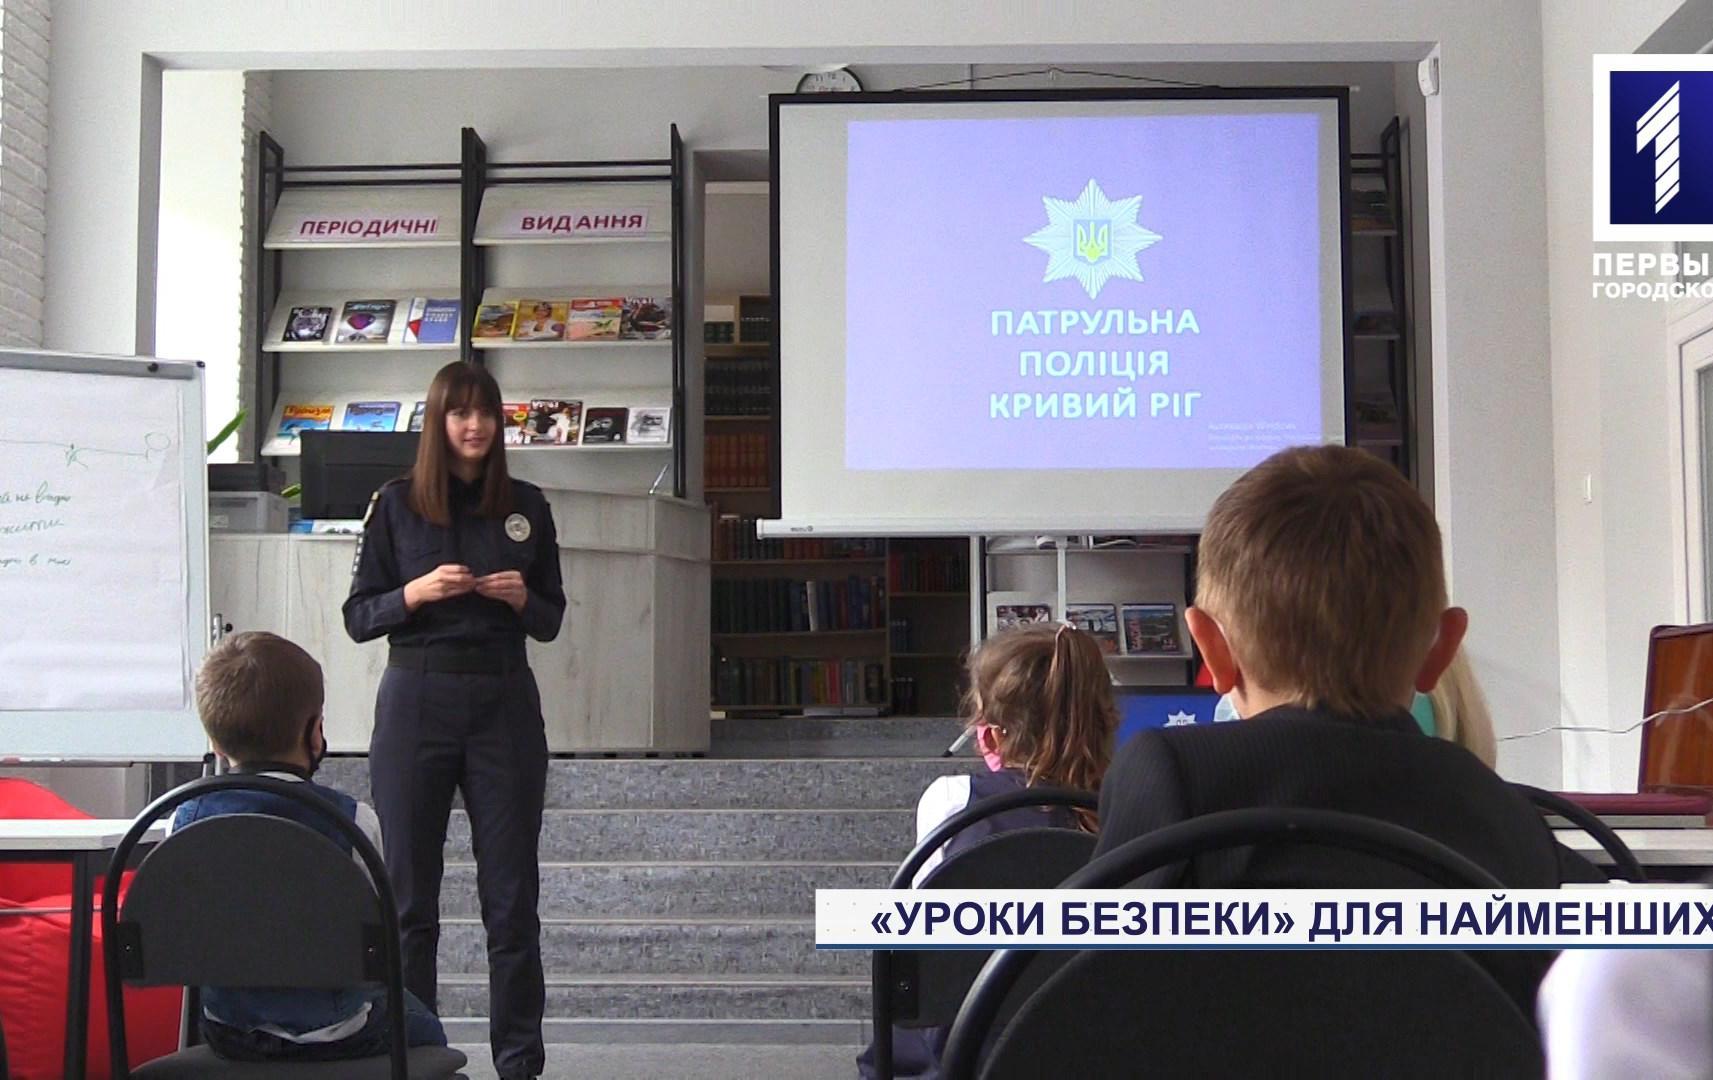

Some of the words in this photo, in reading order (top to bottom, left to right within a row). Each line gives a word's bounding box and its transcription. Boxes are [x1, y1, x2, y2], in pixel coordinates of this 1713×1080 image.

[300, 219, 437, 237] ПЕРІОДИЧНІ
[521, 214, 643, 233] ВИДАННЯ
[991, 309, 1201, 336] ПАТРУЛЬНА
[1019, 350, 1170, 381] ПОЛІЦІЯ
[990, 387, 1137, 418] КРИВИЙ
[1150, 392, 1202, 417] РІГ
